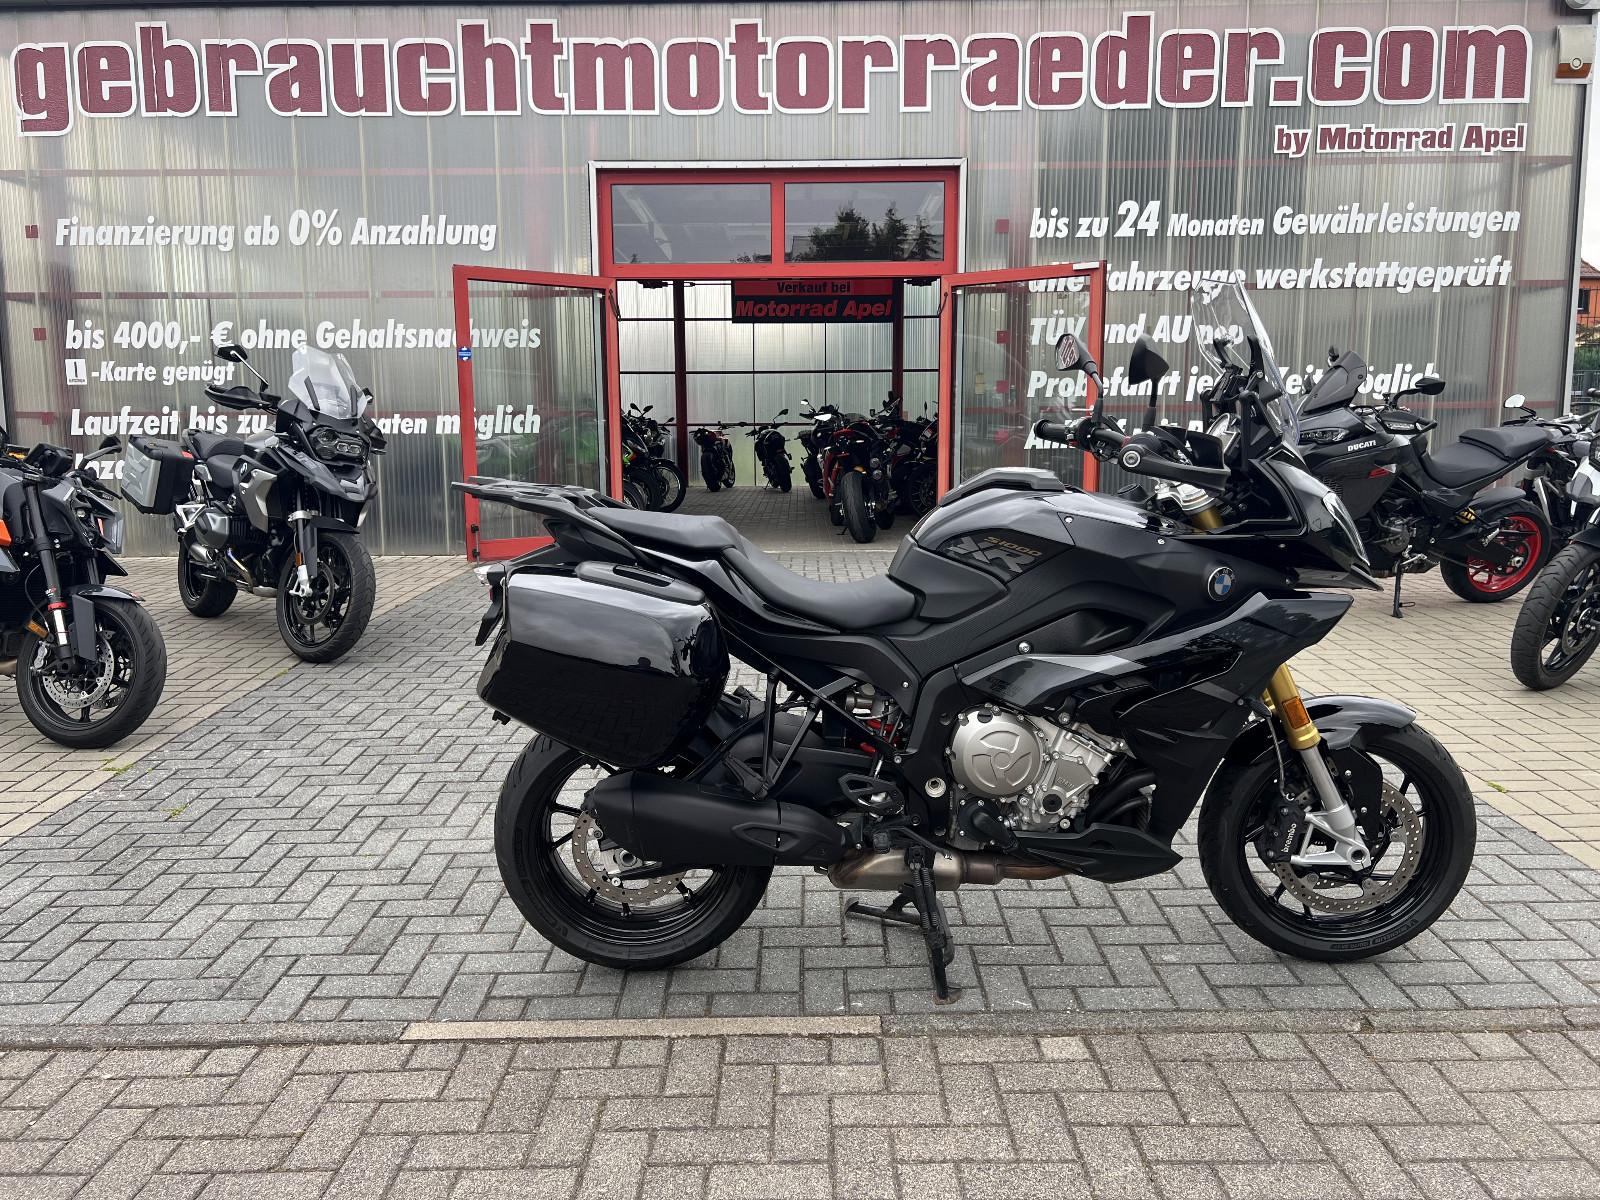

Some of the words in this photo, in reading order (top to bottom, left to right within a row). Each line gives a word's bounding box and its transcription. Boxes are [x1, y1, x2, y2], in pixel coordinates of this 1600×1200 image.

[10, 11, 1532, 137] gebrauchtmotorraeder.com
[1275, 125, 1311, 157] by
[1317, 123, 1456, 153] Motorrad
[1460, 123, 1528, 156] Apel
[55, 215, 235, 251] Finanzierung
[244, 215, 280, 246] ab
[288, 208, 343, 247] 0%
[350, 214, 497, 251] Anzahlung
[1029, 207, 1069, 239] bis
[1075, 216, 1109, 238] zu
[1114, 200, 1161, 237] 24
[1166, 213, 1265, 237] Monaten
[1273, 202, 1521, 239] Gewährleistungen
[777, 281, 827, 294] Verkauf
[831, 281, 851, 293] bei
[1256, 255, 1512, 294] werkstattgeprüft
[735, 299, 839, 318] Motorrad
[843, 299, 893, 320] Apel
[65, 319, 105, 350] bis
[113, 320, 201, 355] 4000,-
[210, 320, 234, 346] €
[240, 319, 308, 350] ohne
[1030, 309, 1086, 346] TÜV
[1152, 315, 1193, 344] AU
[162, 360, 235, 386] genügt
[71, 406, 180, 435] Laufzeit
[189, 405, 228, 435] bis
[238, 414, 268, 434] zu
[435, 404, 541, 441] mglich
[1347, 440, 1377, 452] DUCATI
[983, 536, 1043, 557] S1000
[1280, 823, 1297, 853] brembo
